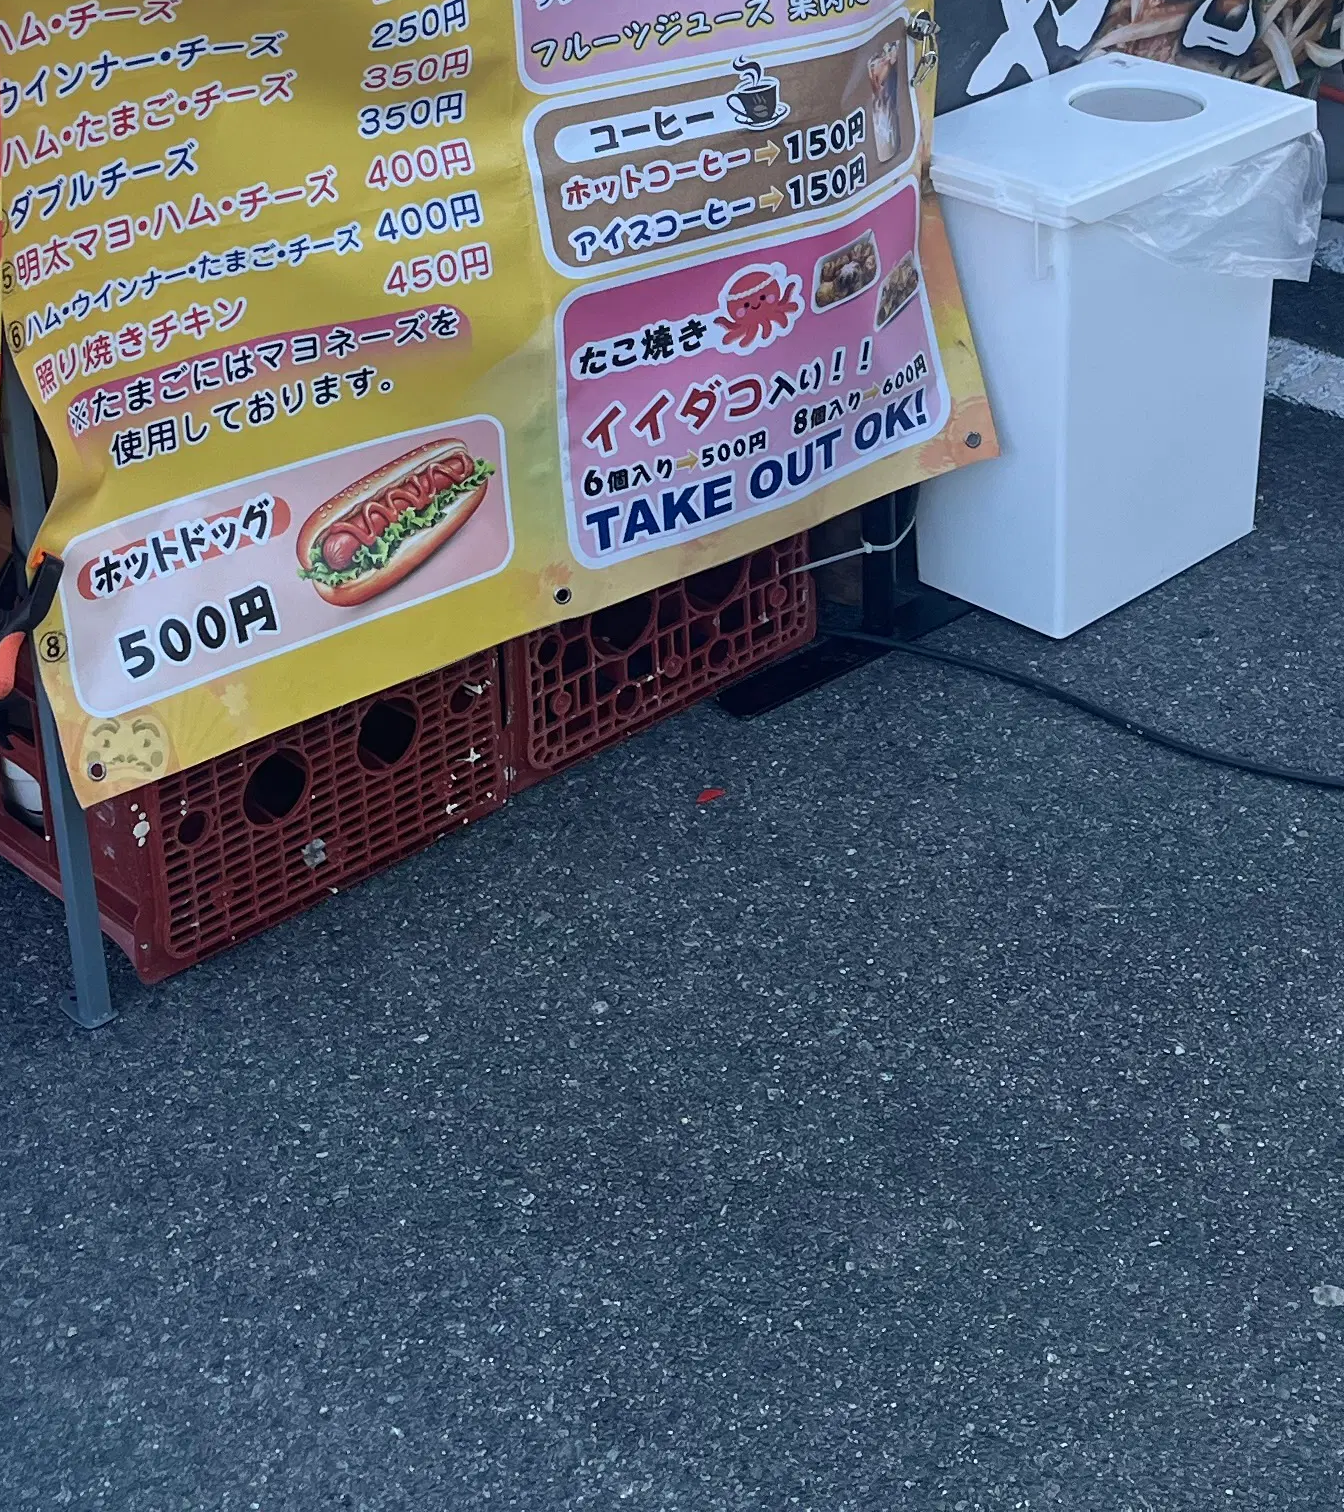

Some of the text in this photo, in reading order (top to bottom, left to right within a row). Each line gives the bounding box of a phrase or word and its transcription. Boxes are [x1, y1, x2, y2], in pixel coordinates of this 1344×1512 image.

[372, 0, 466, 48] 250円
[4, 50, 469, 173] ハム・たまご・チーズ 350円
[11, 143, 197, 230] ダブルチーズ
[360, 93, 463, 135] 350円
[566, 114, 865, 206] ホットコーヒー 150円
[590, 112, 714, 153] コーヒー
[17, 167, 336, 286] 明太マヨ・ハム・チーズ
[368, 142, 472, 188] 400円
[573, 162, 865, 260] アイスコーヒー 150円
[27, 226, 360, 342] ハム・ウインナー・たまご・チーズ
[378, 194, 481, 240] 400円
[35, 246, 491, 398] 照り焼きチキン 450円
[69, 306, 459, 433] ※たまごにはマヨネーズを
[579, 319, 707, 375] たこ焼き
[111, 368, 394, 465] 使用しております。
[585, 355, 928, 497] 6個入り 500円 8個入り 600円
[586, 390, 928, 552] TAKE OUT OK!
[94, 495, 275, 595] ホットドッグ
[118, 586, 279, 679] 500円
